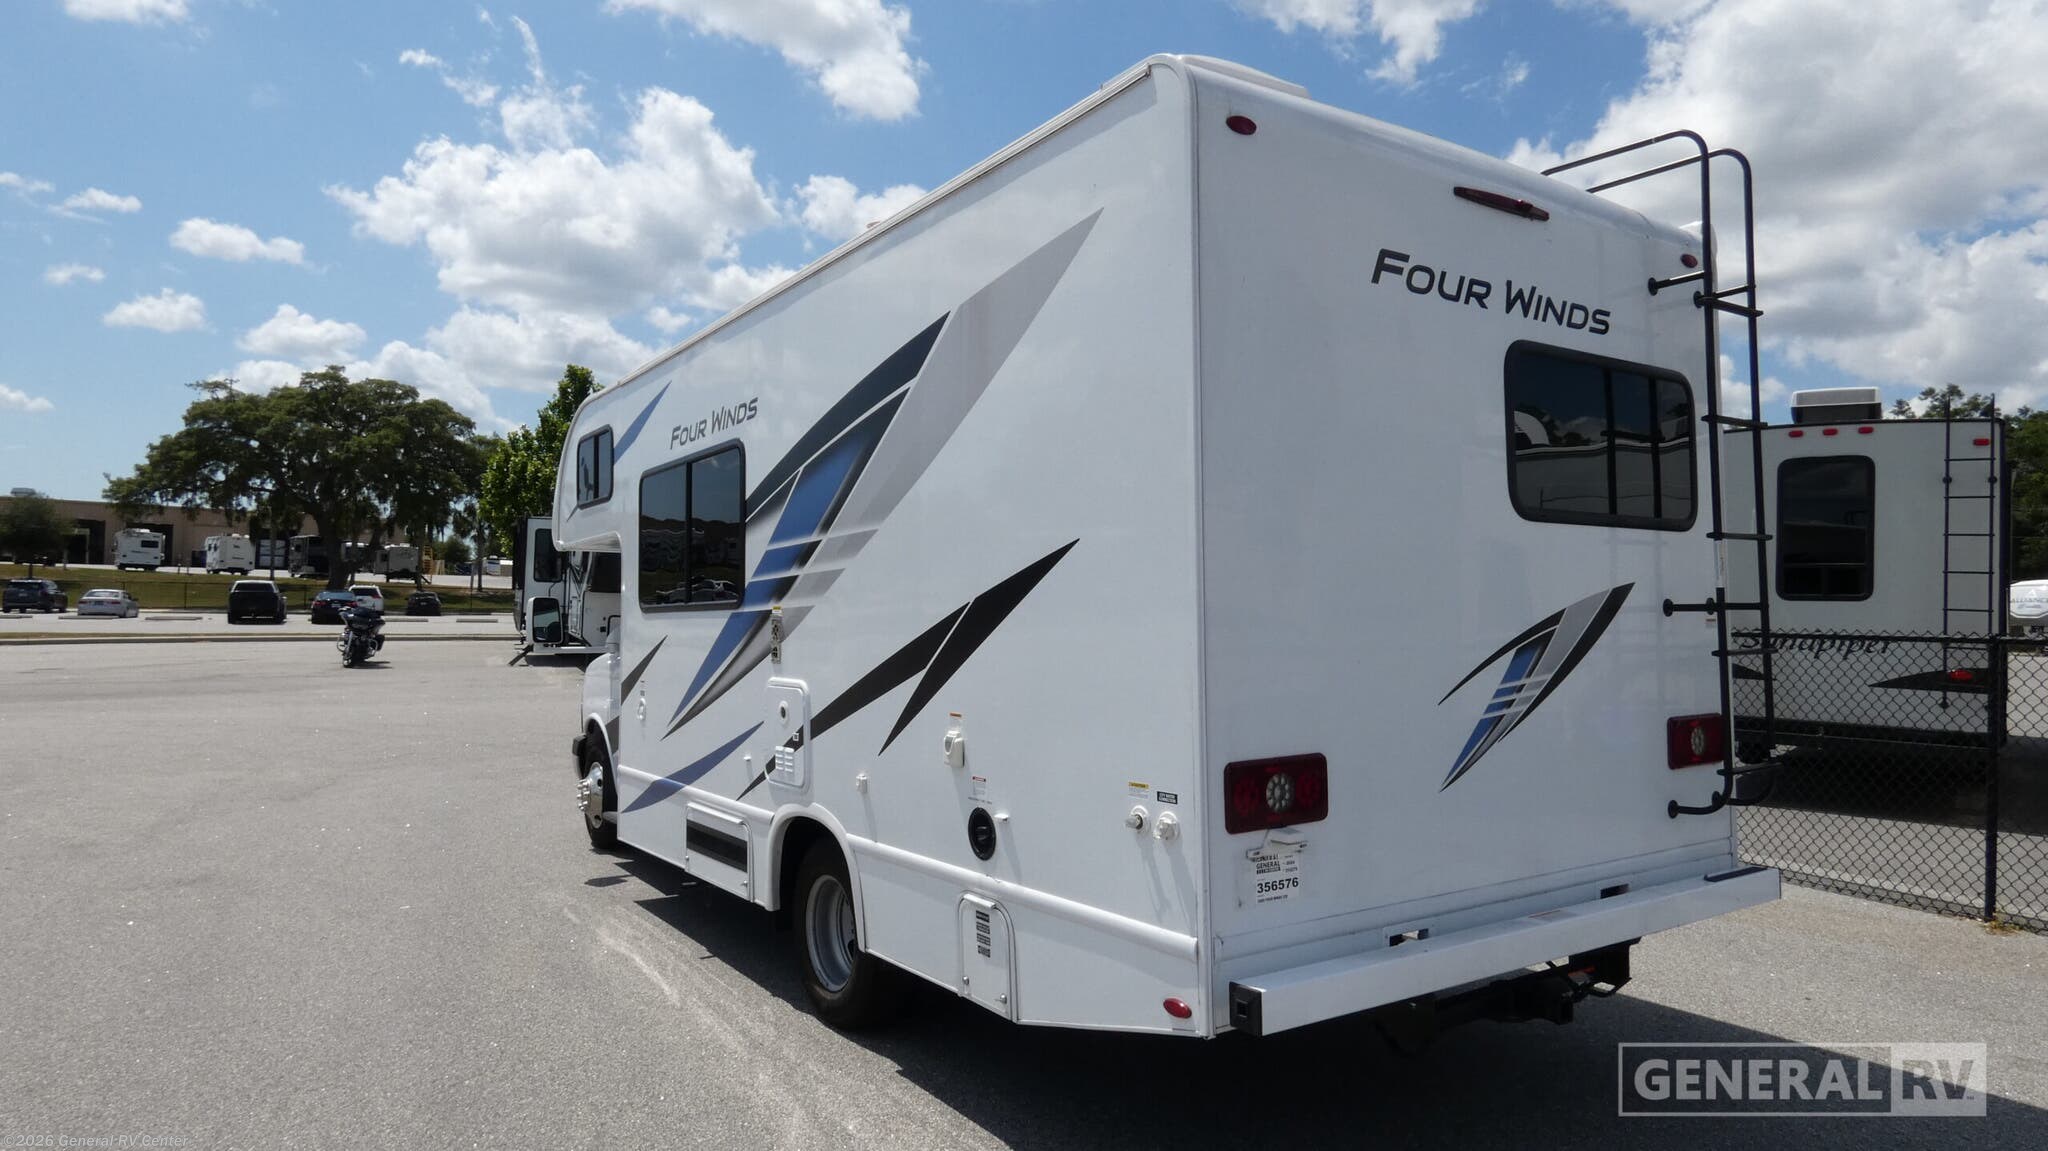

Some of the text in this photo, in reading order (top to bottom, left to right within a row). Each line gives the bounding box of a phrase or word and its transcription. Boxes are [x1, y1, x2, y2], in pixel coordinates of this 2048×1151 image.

[1371, 248, 1611, 336] FOUR WINDS
[670, 396, 759, 450] FOUR WINDS
[1257, 877, 1299, 894] 356576
